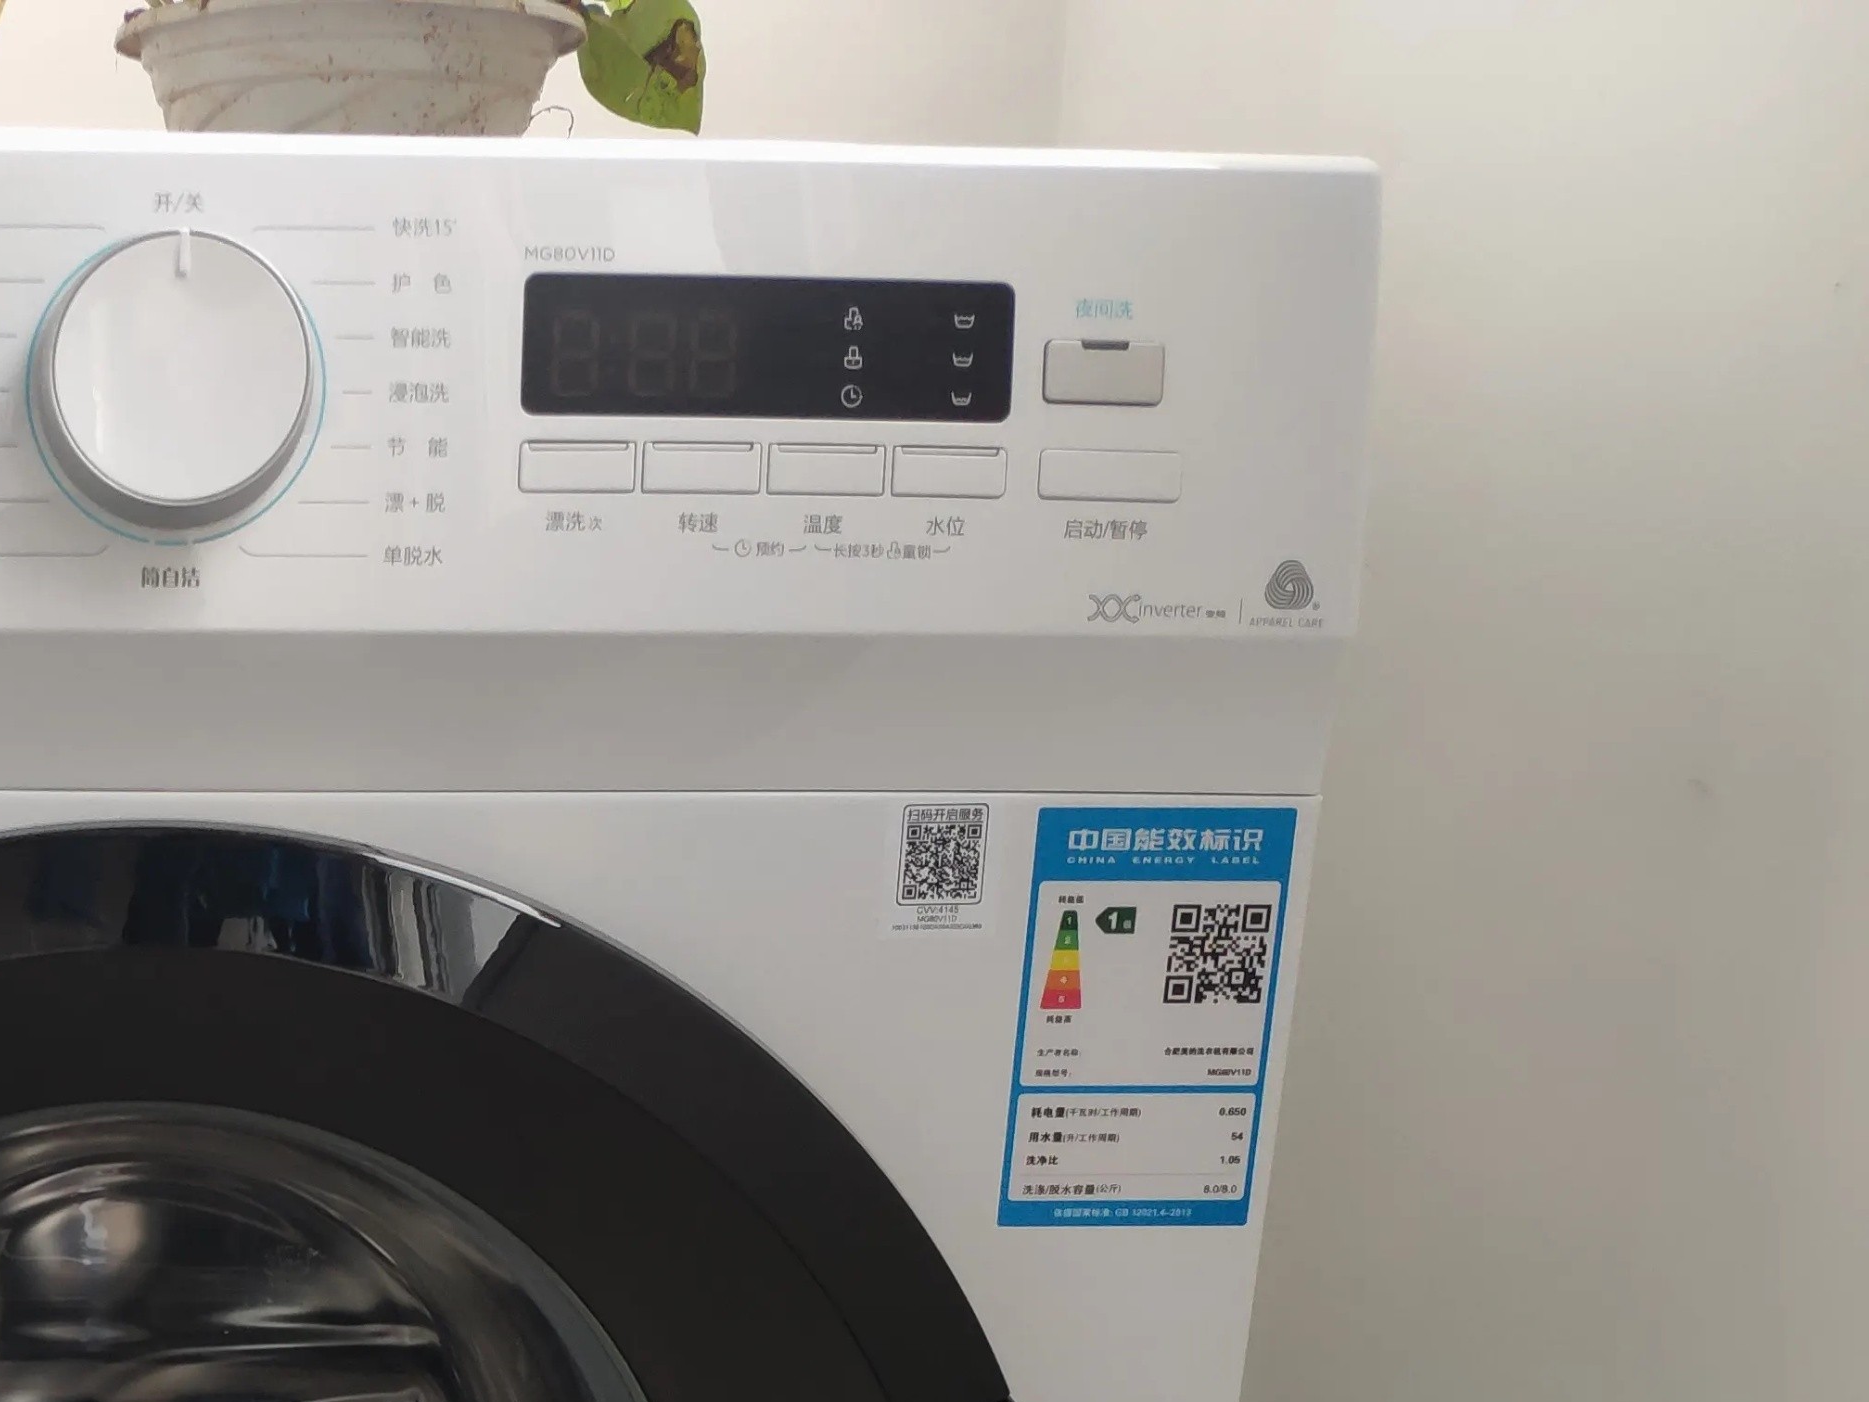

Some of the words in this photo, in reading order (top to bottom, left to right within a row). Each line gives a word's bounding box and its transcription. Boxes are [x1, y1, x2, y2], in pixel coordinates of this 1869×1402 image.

[154, 191, 204, 213] 开/关
[524, 246, 616, 262] MG80V11D
[390, 327, 451, 349] 智能洗
[389, 382, 450, 404] 浸泡洗
[678, 511, 719, 533] 转速
[803, 514, 843, 535] 温度
[926, 516, 965, 537] 水位
[1063, 519, 1148, 541] 启动/暂停
[383, 545, 443, 567] 单脱水
[755, 541, 785, 558] 预约
[1138, 600, 1202, 620] inverter
[906, 807, 985, 822] 扫码开启服务
[1067, 827, 1265, 852] 中国能效标识
[1066, 855, 1117, 865] CHINA
[1132, 855, 1197, 865] ENERGY
[1211, 856, 1261, 865] LABEL
[1231, 1132, 1245, 1142] 54
[1026, 1155, 1059, 1166] 洗净比
[1220, 1156, 1241, 1166] 1.05
